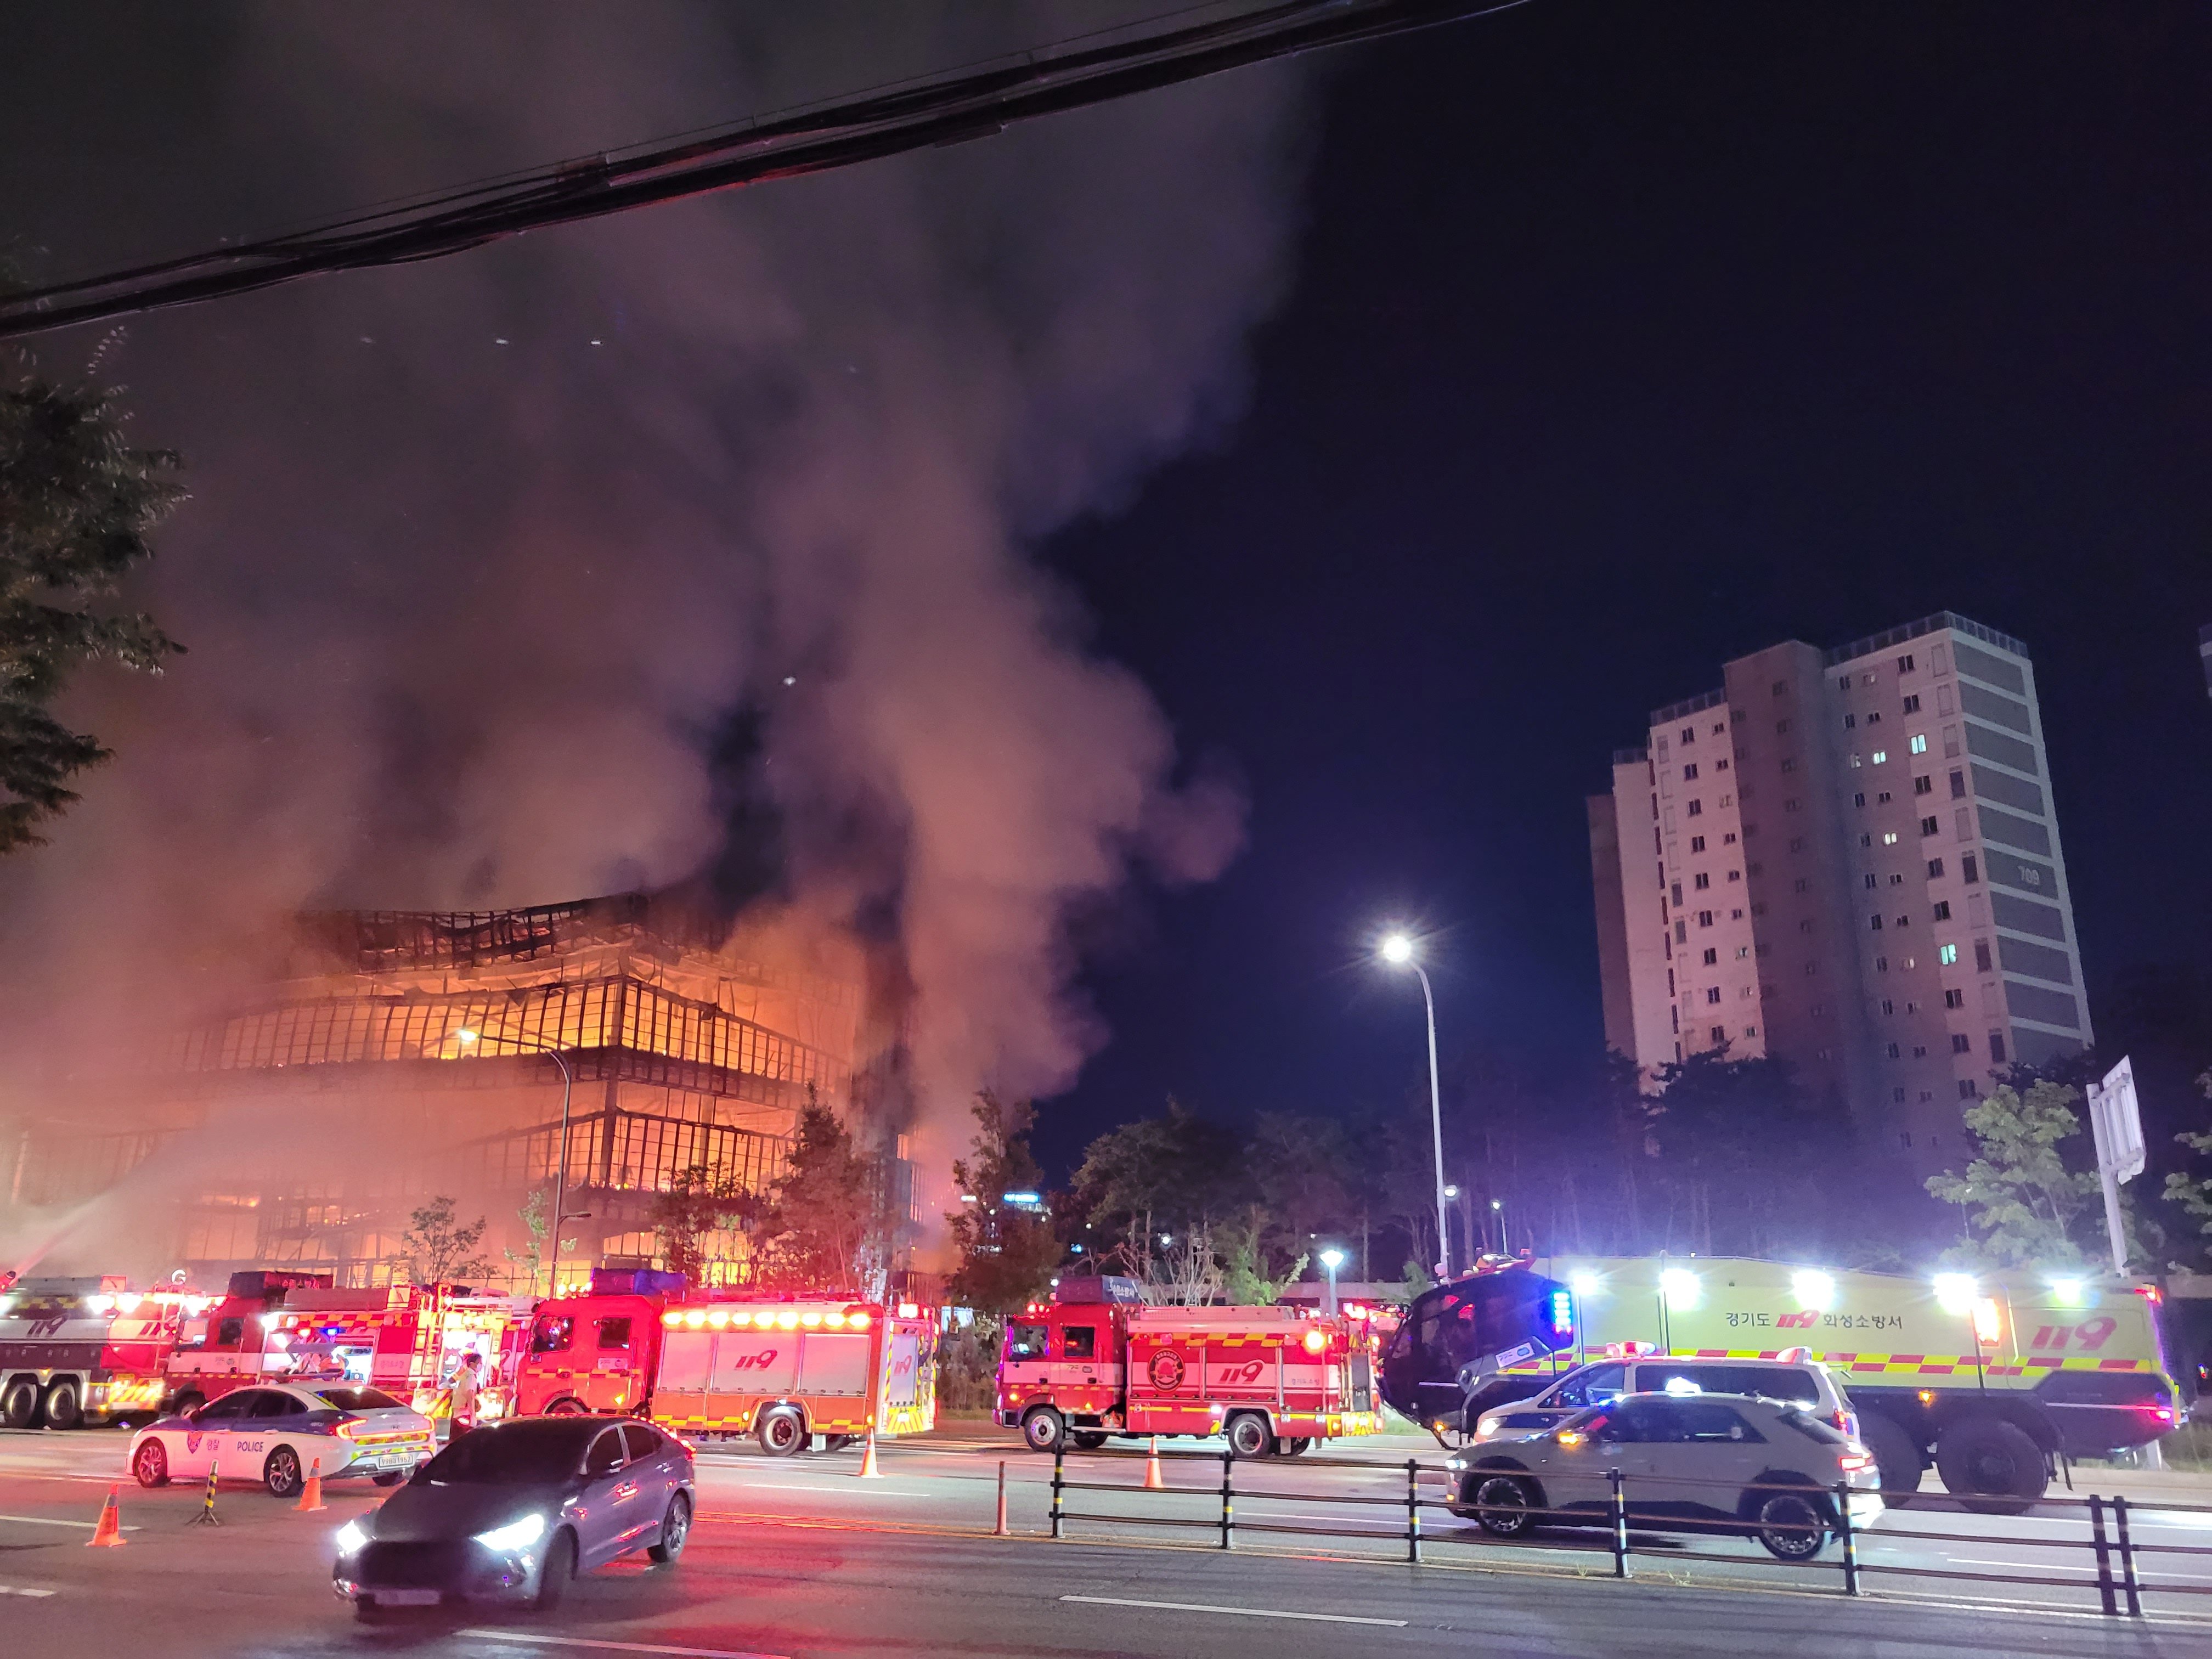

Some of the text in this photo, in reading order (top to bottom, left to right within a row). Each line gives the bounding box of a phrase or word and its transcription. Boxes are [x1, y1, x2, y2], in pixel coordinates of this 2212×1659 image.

[26, 1313, 70, 1338] 119
[1726, 1310, 1903, 1329] 경기도 119 화성소방서
[2030, 1317, 2117, 1350] 119
[735, 1350, 777, 1369] 119
[894, 1355, 912, 1376] 119
[1218, 1362, 1263, 1384] 119
[207, 1439, 263, 1452] 경찰 POLICE
